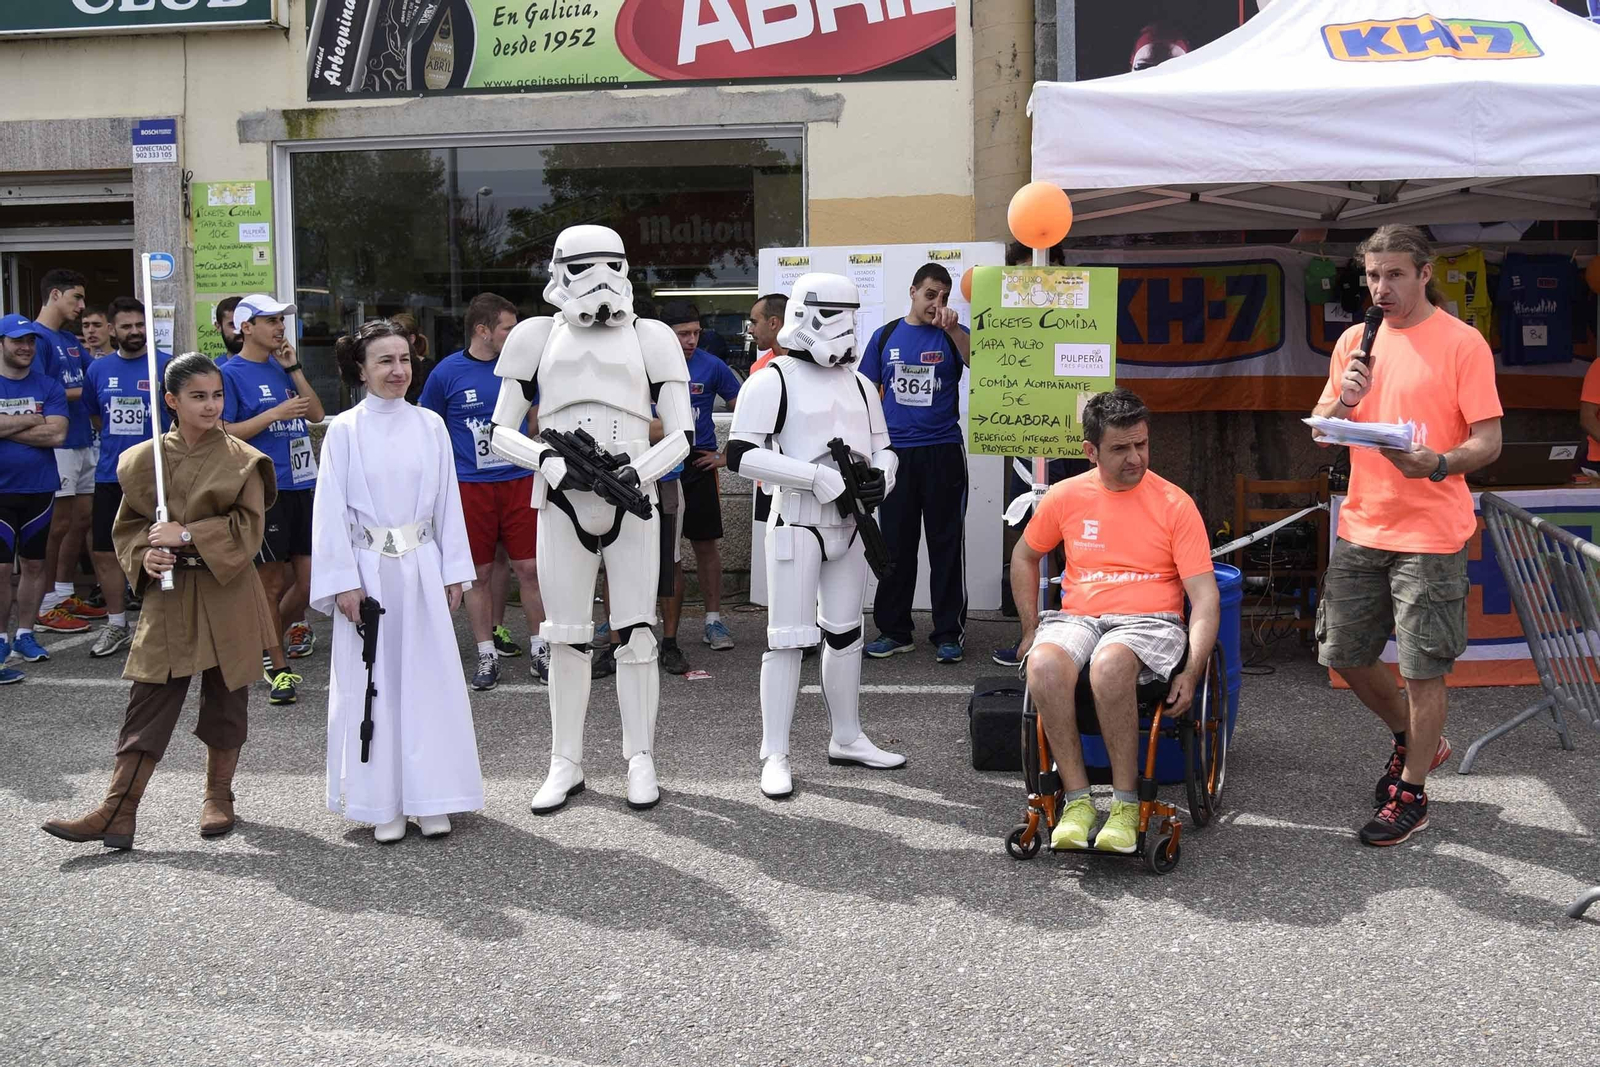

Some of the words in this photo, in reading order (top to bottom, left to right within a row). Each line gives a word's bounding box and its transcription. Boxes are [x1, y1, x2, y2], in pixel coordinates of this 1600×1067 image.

[493, 6, 518, 26] En
[525, 0, 599, 29] Galicia,
[677, 0, 955, 65] ABR
[1339, 19, 1514, 57] KH-7
[323, 0, 357, 86] Arbequina
[493, 34, 537, 57] desde
[543, 27, 596, 53] 1952
[314, 47, 325, 78] variedad
[426, 61, 451, 72] ABRIL
[483, 73, 619, 88] www.aceitesabril.com
[976, 337, 1005, 350] TAPA
[1010, 337, 1044, 350] PULPO
[996, 352, 1032, 368] 10€
[896, 377, 931, 395] 364
[978, 374, 1019, 389] COMIDA
[1001, 391, 1030, 408] 5€
[112, 408, 142, 424] 339
[990, 412, 1061, 427] COLABORA
[1065, 434, 1085, 444] PAR
[981, 443, 1025, 454] PROYECTOS
[1027, 445, 1040, 455] DE
[1042, 446, 1053, 455] LA
[1057, 447, 1084, 456] FUND
